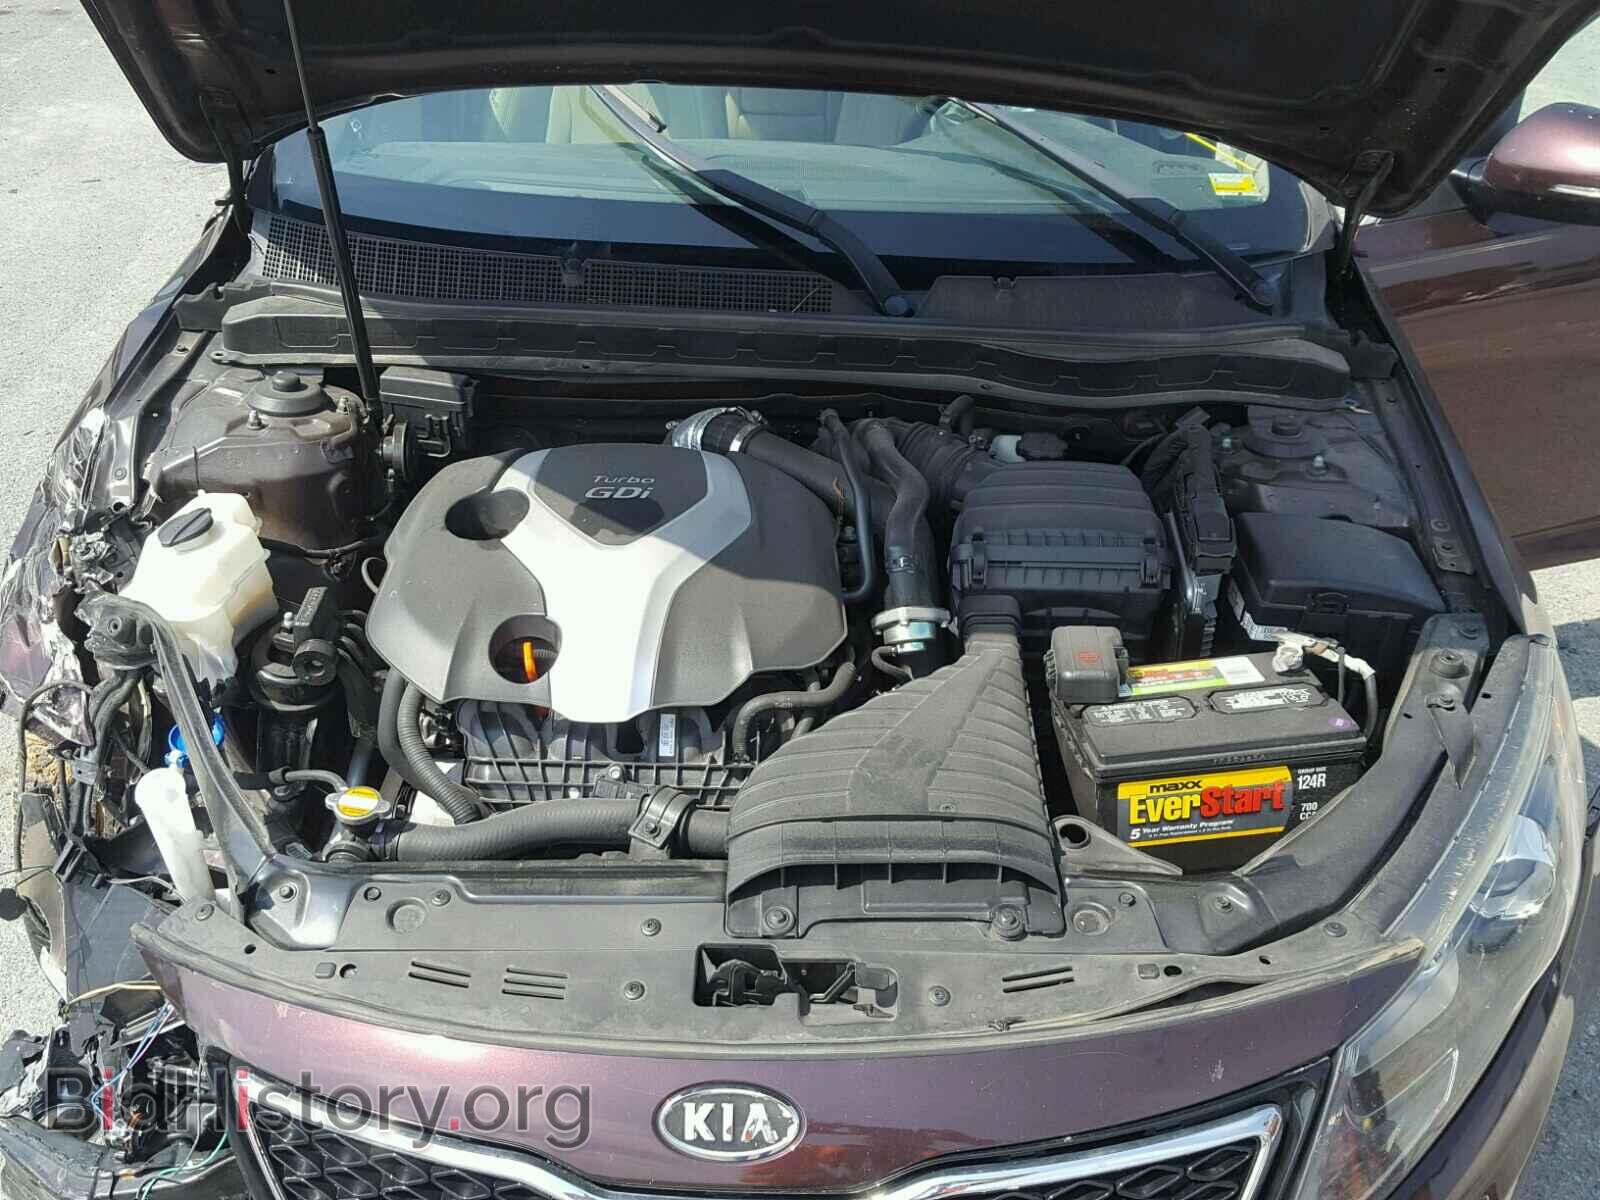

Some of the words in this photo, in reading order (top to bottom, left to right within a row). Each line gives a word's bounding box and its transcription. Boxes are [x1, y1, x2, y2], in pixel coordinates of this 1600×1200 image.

[592, 475, 655, 484] Turbo
[584, 486, 654, 499] GDi
[1149, 779, 1202, 794] maxx
[1297, 772, 1327, 790] 124R
[1128, 777, 1286, 826] EverStart
[1300, 801, 1318, 812] 700
[1129, 828, 1141, 840] 5
[1142, 826, 1161, 835] Year
[1161, 822, 1197, 833] Warranty
[1199, 818, 1236, 829] Program
[682, 1102, 779, 1144] KIA
